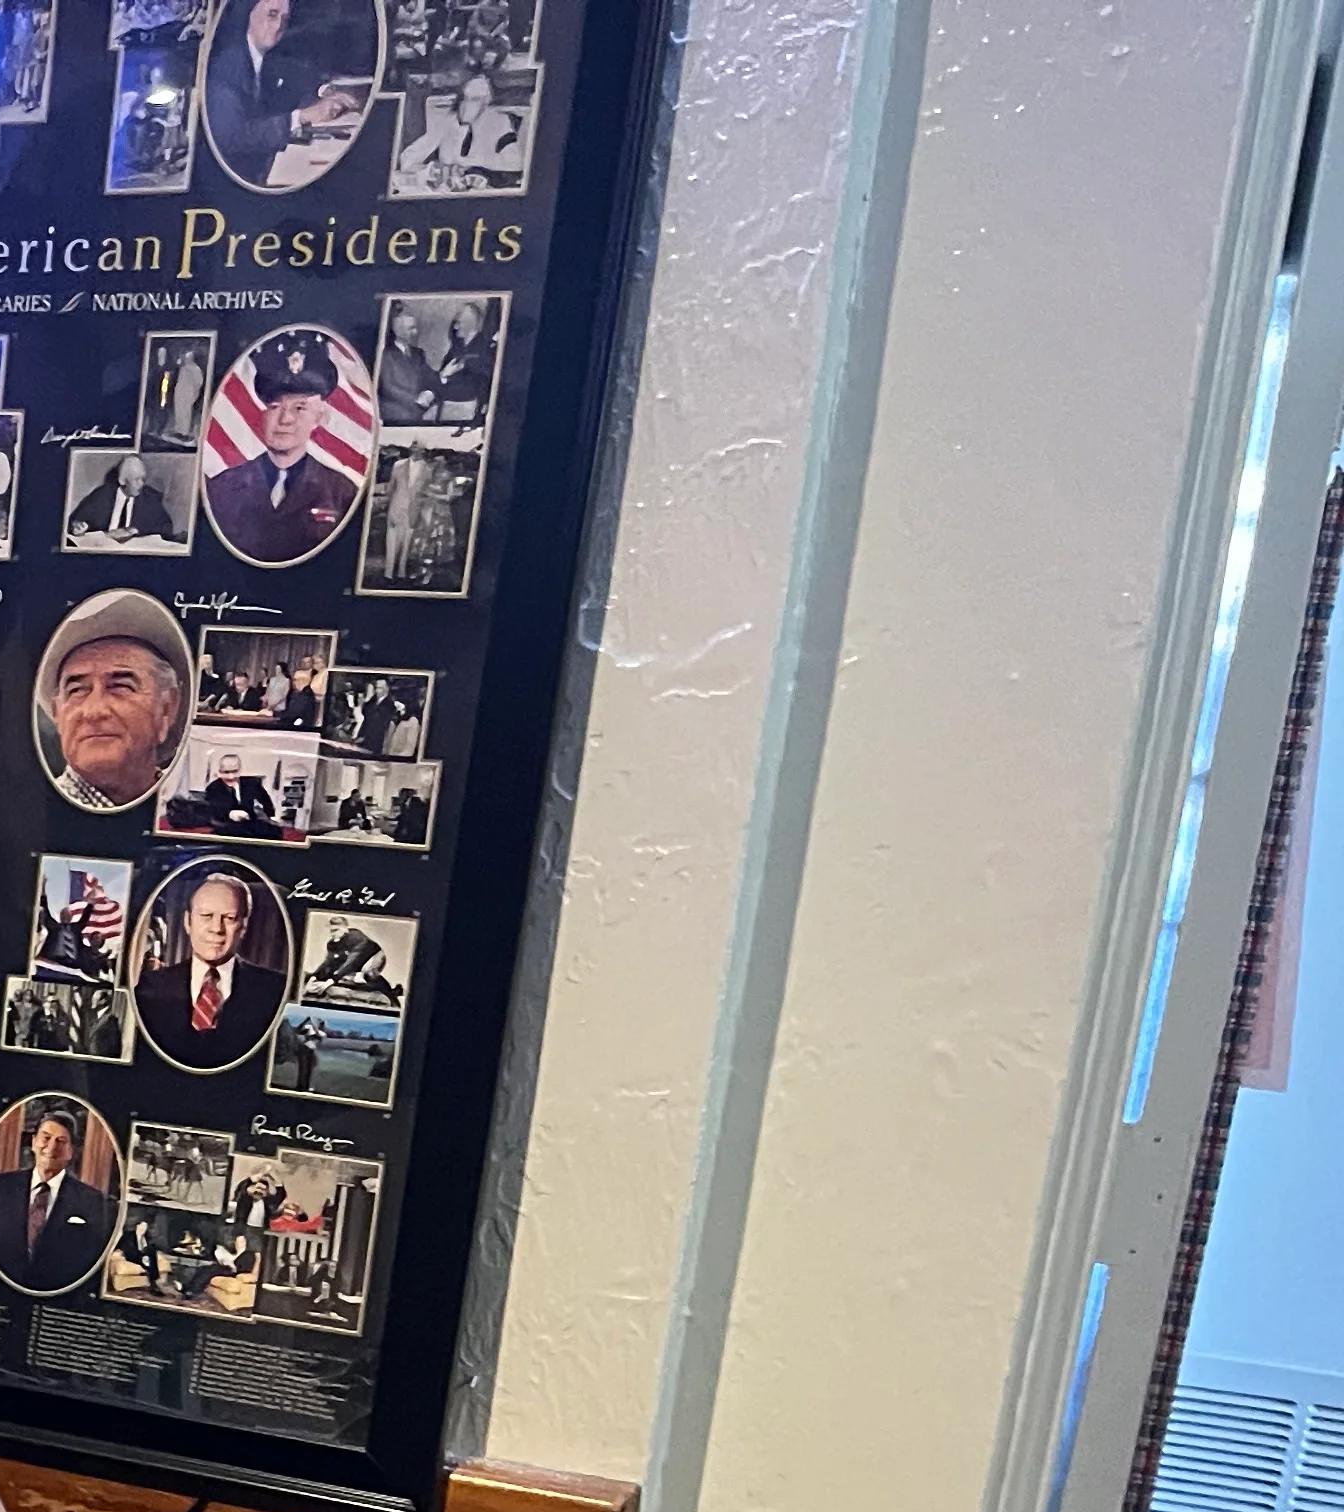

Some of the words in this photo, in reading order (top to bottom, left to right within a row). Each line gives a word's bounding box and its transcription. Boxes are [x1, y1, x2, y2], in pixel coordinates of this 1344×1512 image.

[176, 207, 523, 280] Presidents
[92, 292, 185, 310] NATIONAL
[188, 290, 284, 310] ARCHIVES
